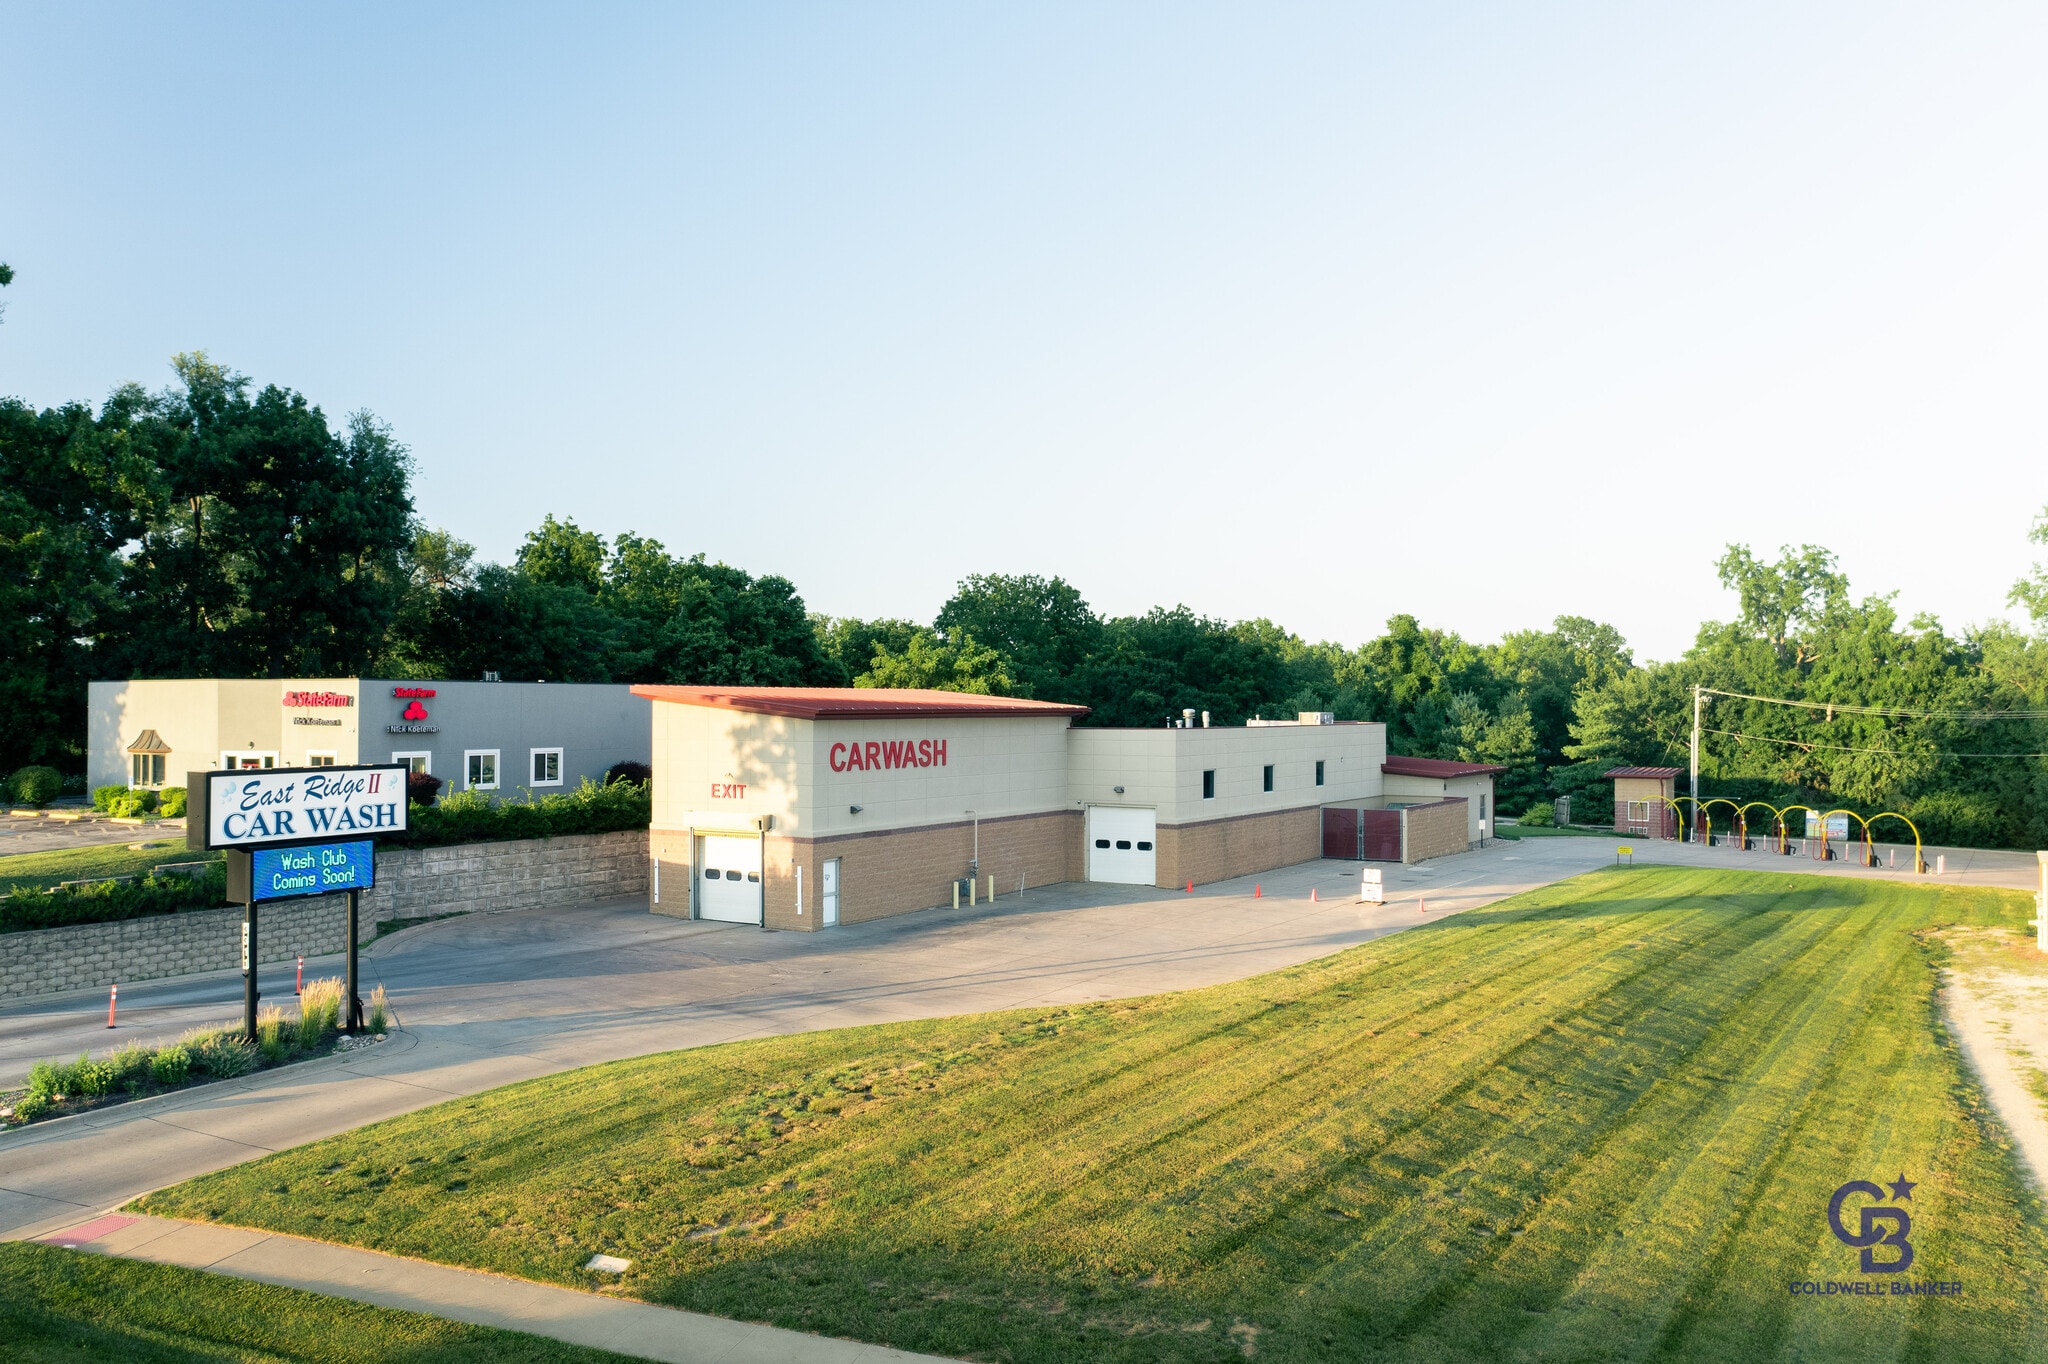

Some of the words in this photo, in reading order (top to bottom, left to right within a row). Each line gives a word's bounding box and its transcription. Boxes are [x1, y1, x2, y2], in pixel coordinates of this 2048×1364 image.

[829, 739, 947, 773] CARWASH
[240, 780, 295, 811] East
[303, 773, 365, 802] Ridge
[367, 773, 382, 794] II
[711, 783, 747, 799] EXIT
[223, 810, 296, 839] CAR
[305, 803, 398, 832] WASH
[281, 852, 316, 871] Wash
[321, 848, 347, 866] Club
[273, 873, 316, 890] Coming
[322, 865, 355, 884] Soon!
